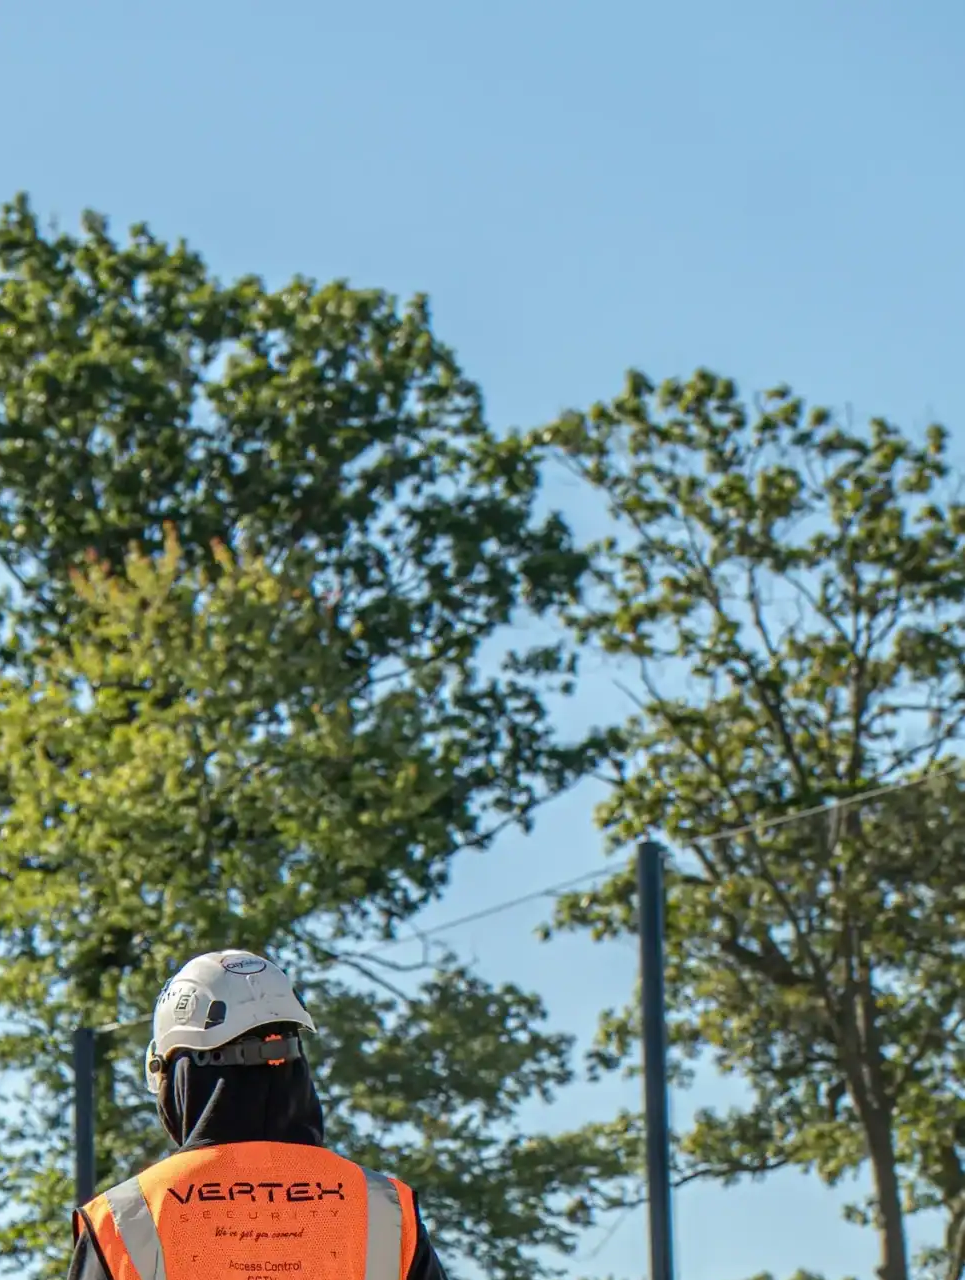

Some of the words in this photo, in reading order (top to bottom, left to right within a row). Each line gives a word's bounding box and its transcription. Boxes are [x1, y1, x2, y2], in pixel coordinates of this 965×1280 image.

[167, 1182, 345, 1204] VERTEX
[180, 1210, 339, 1223] SECURITY
[239, 1229, 253, 1241] got
[255, 1230, 269, 1242] you
[229, 1260, 262, 1271] Access
[264, 1261, 302, 1271] Control
